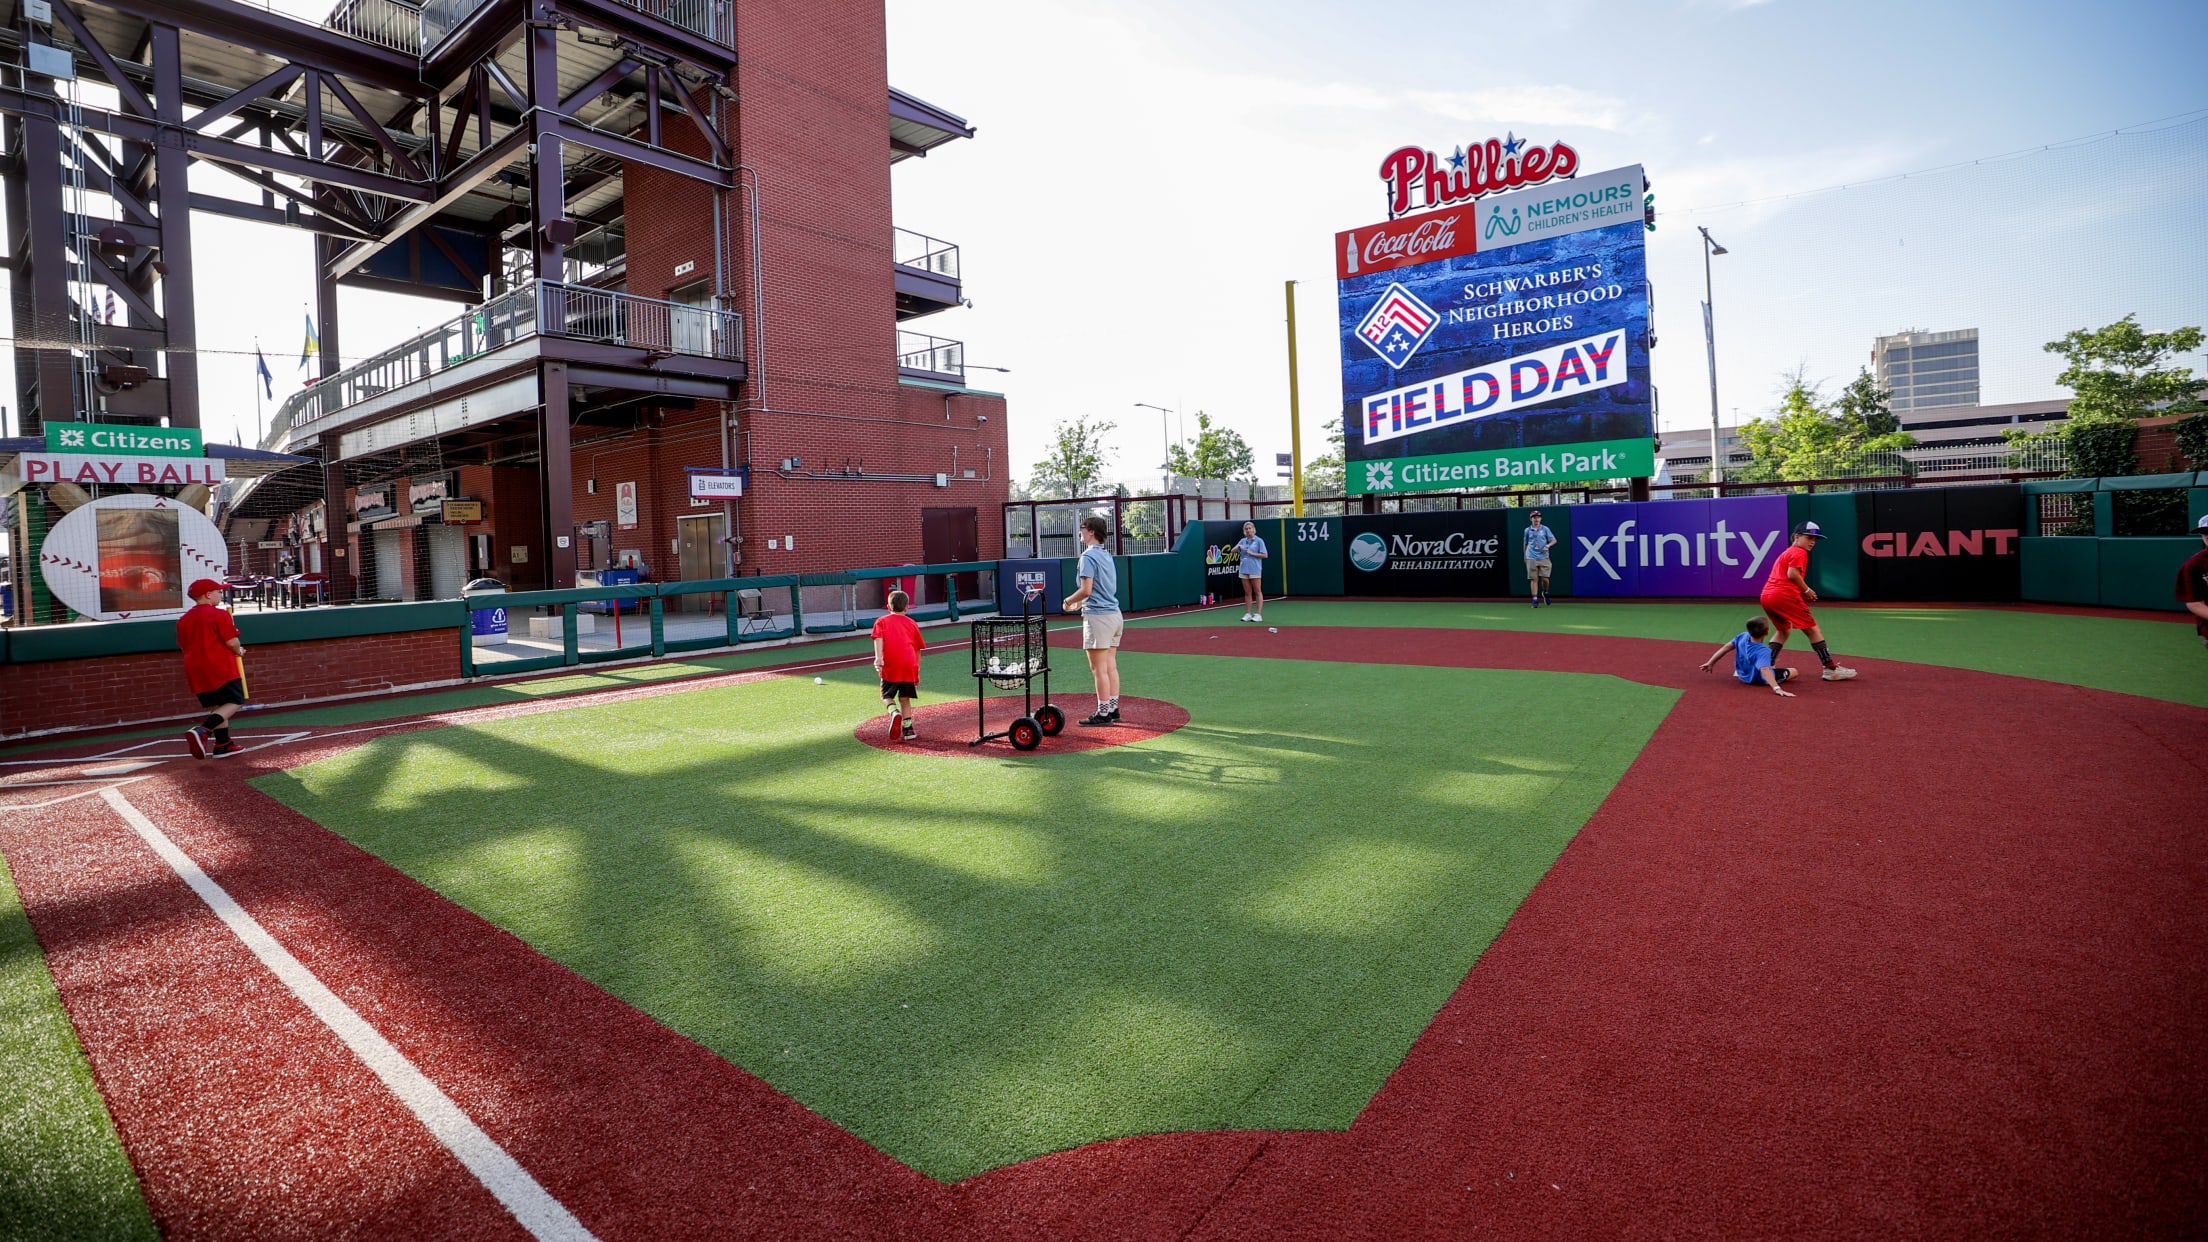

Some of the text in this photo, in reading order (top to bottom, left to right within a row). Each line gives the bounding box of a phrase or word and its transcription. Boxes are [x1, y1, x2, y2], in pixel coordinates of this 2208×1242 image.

[1379, 134, 1580, 215] Phillies
[1527, 183, 1632, 218] NEMOURS
[1527, 201, 1633, 231] CHILDREN'S HEALTH
[1364, 214, 1460, 264] Coca-Cola
[1464, 264, 1602, 299] SCHWARBER'S
[1448, 284, 1622, 324] NEIGHBORHOOD
[1372, 315, 1391, 334] 12
[1493, 315, 1573, 340] HEROES
[1368, 335, 1620, 438] FIELD DAY
[90, 431, 192, 450] Citizens
[26, 460, 221, 484] PLAY BALL
[1401, 463, 1490, 483] Citizens
[1495, 457, 1555, 478] Bank
[707, 481, 735, 490] ELEVATORS
[1297, 521, 1330, 542] 334
[1862, 529, 2018, 558] GIANT
[1389, 533, 1498, 556] NovaCare
[1576, 519, 1780, 580] xfinity
[1207, 565, 1240, 576] PHILADELP
[1390, 559, 1495, 570] REHABILITATION
[1017, 573, 1044, 582] MLB
